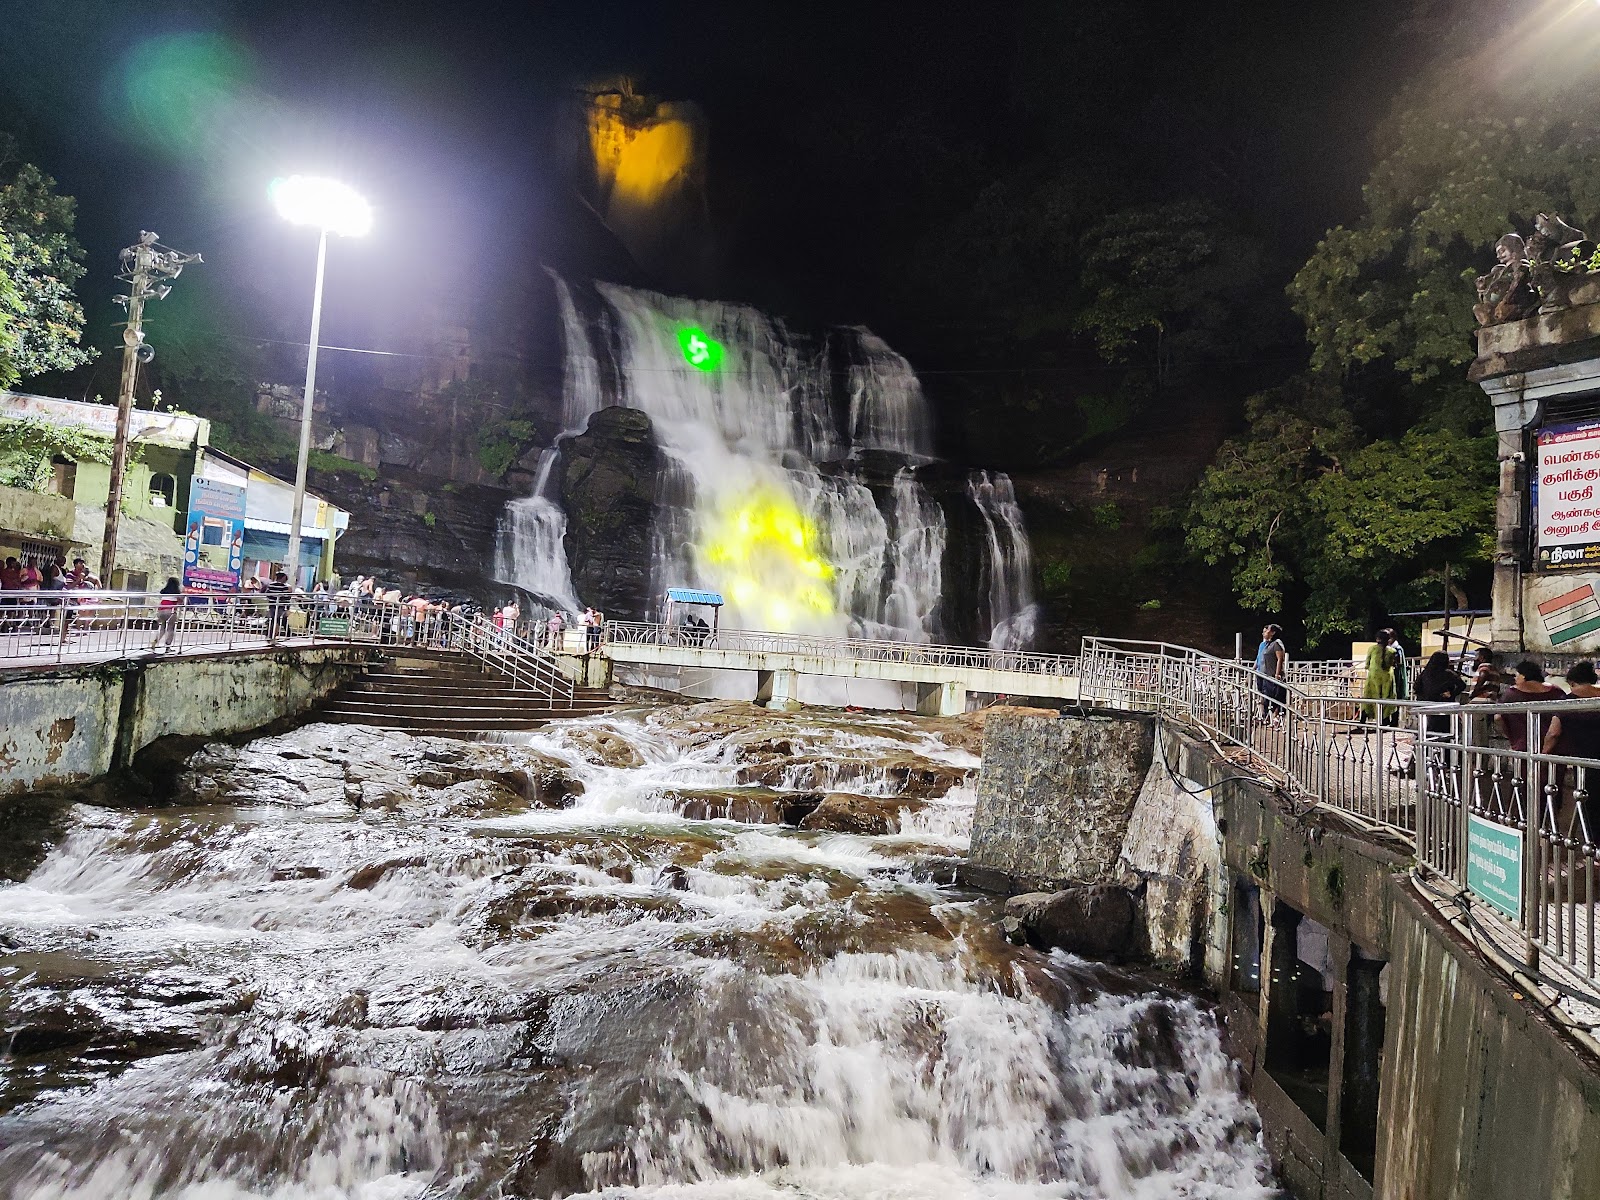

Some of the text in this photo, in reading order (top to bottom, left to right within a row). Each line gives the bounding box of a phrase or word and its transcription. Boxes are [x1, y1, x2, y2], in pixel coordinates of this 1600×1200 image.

[1543, 468, 1600, 486] குளிக்கு
[1559, 485, 1593, 502] பகுதி
[1543, 521, 1589, 538] அனுமதி
[1551, 546, 1584, 564] நிலா
